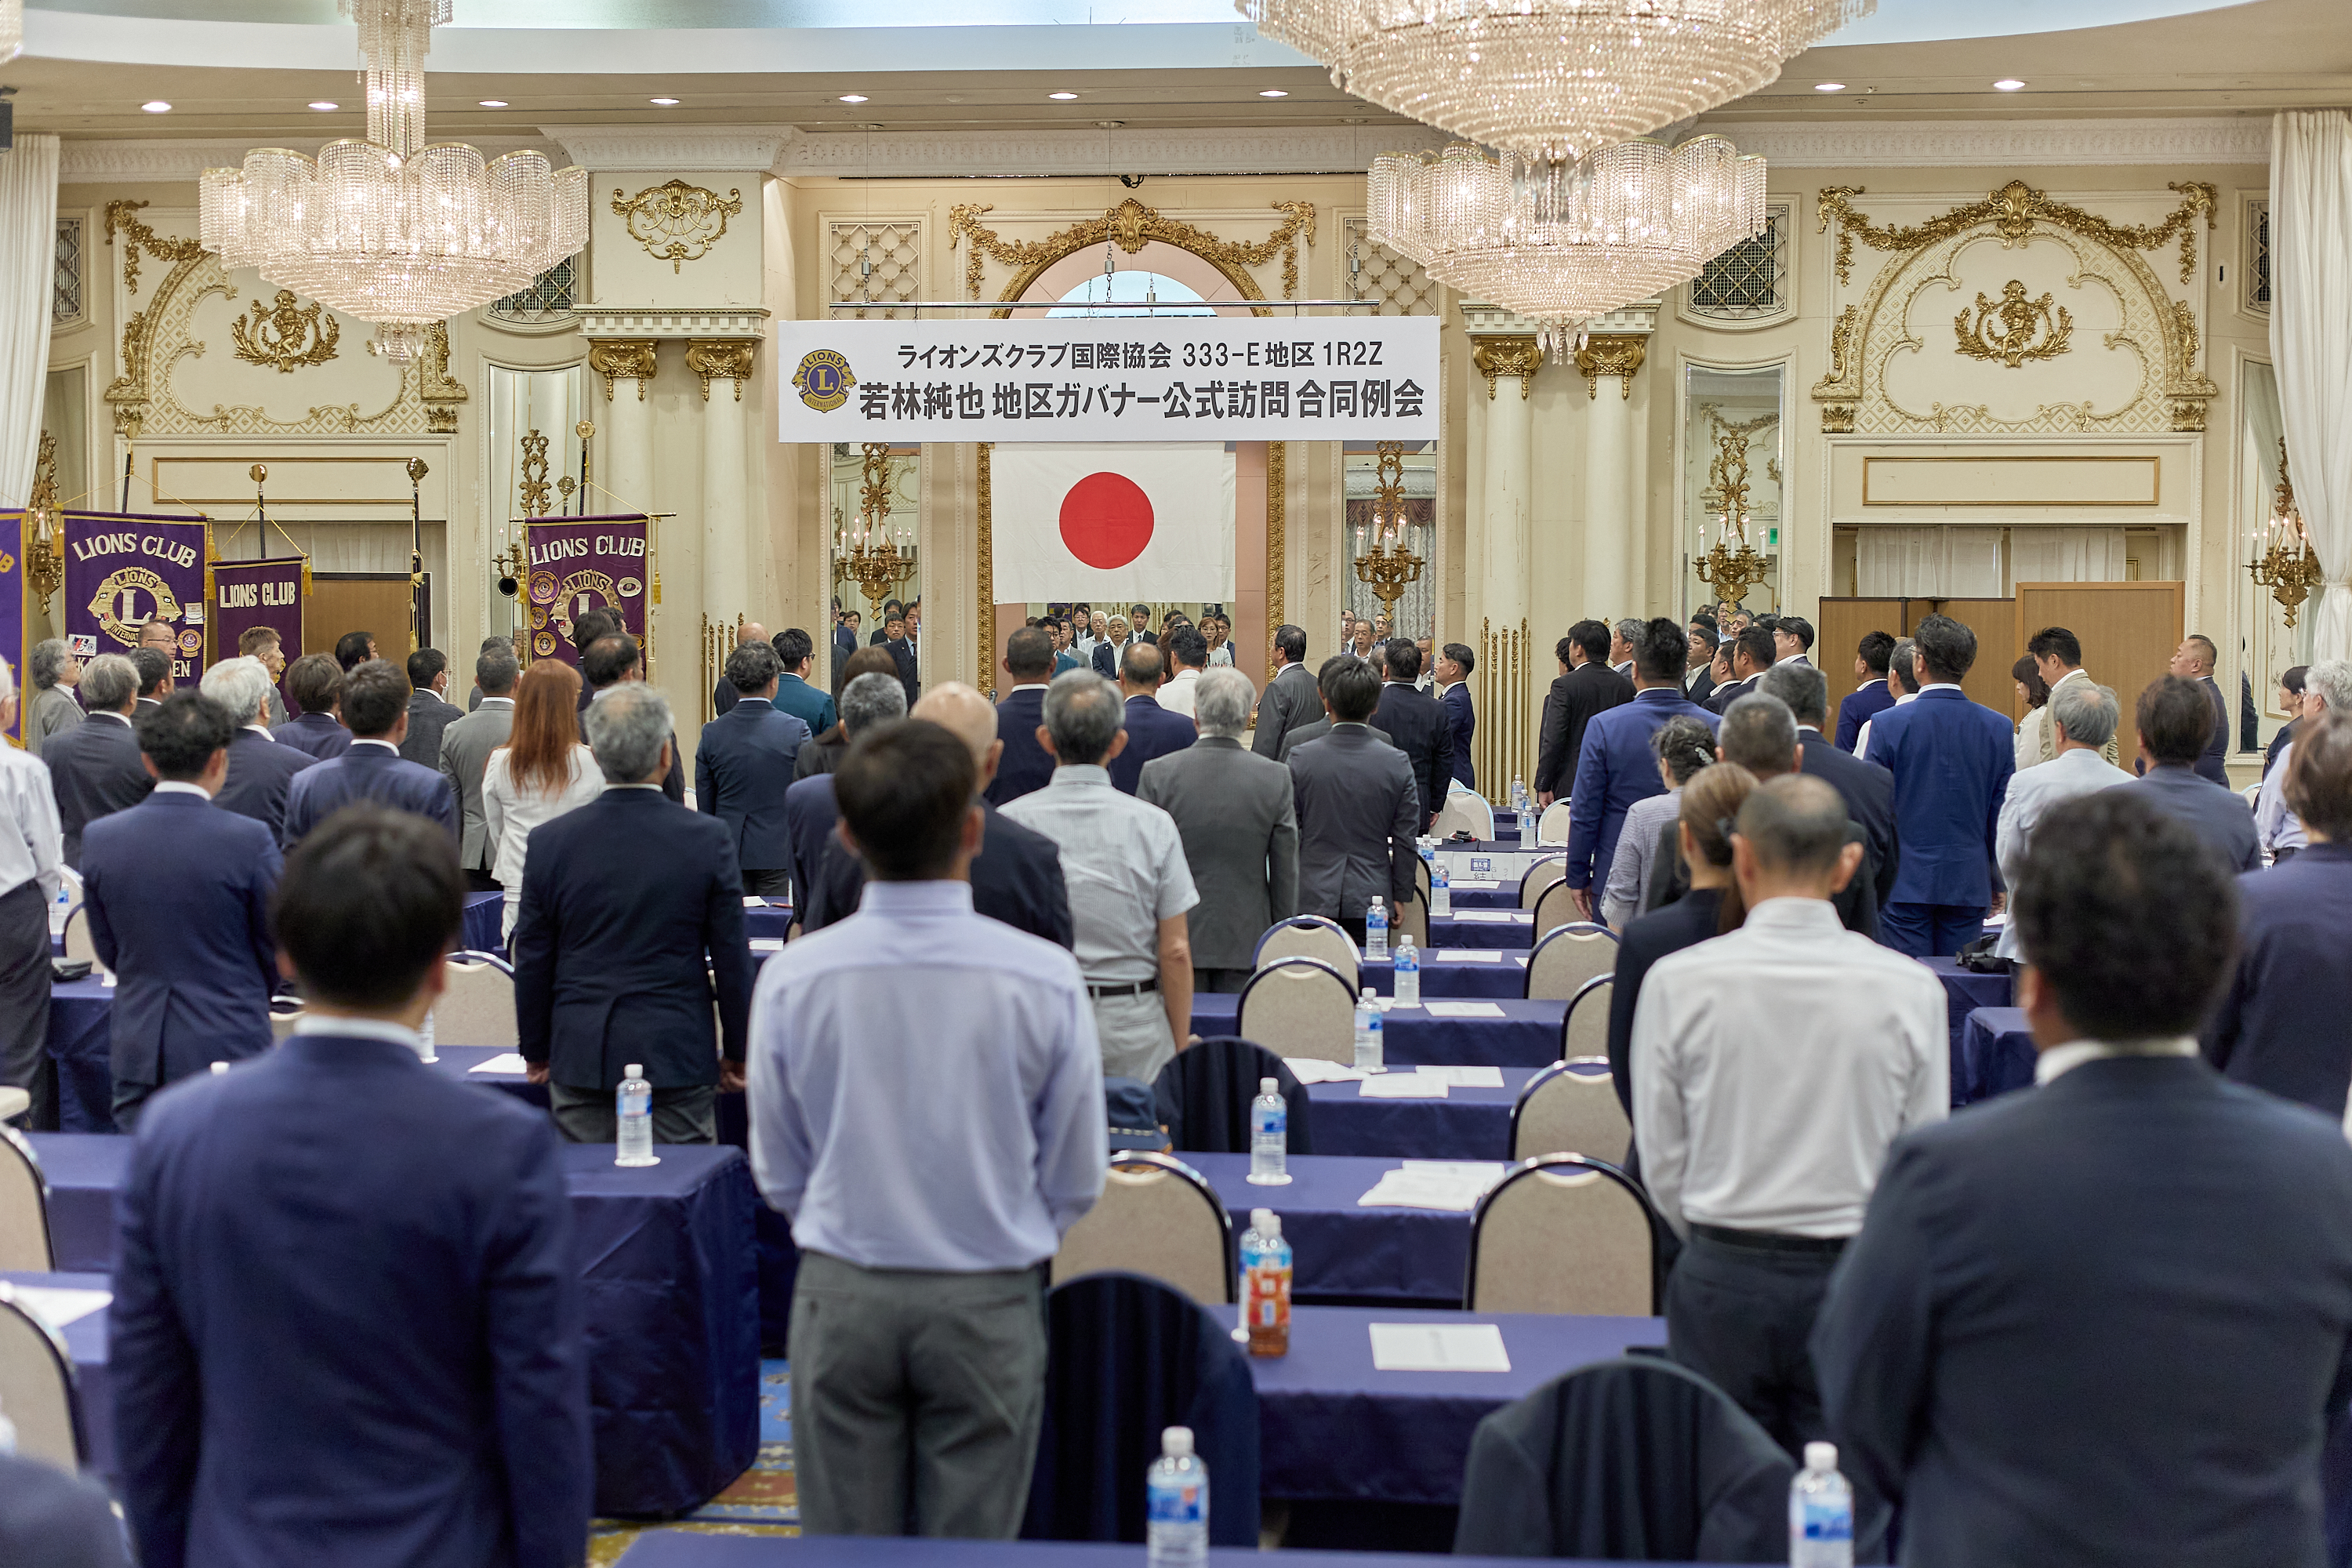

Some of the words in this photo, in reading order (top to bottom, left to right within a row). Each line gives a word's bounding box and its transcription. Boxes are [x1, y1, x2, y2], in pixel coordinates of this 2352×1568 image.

[806, 352, 843, 365] LIONS
[898, 341, 1172, 369] ライオンズクラブ国際協会
[1323, 341, 1383, 366] 1R2Z
[817, 368, 834, 390] L
[806, 396, 843, 408] INTERNATIONAL
[859, 381, 985, 420] 若林純也
[1295, 378, 1425, 419] 合同例会
[71, 533, 137, 562] LIONS
[141, 535, 197, 568] CLUB
[529, 537, 589, 565] LIONS
[595, 535, 646, 557] CLUB
[115, 571, 157, 587] LIONS
[568, 573, 608, 590] LIONS
[220, 583, 258, 608] LIONS
[261, 581, 296, 606] CLUB
[120, 589, 153, 625] L
[111, 624, 139, 641] INTERNAT
